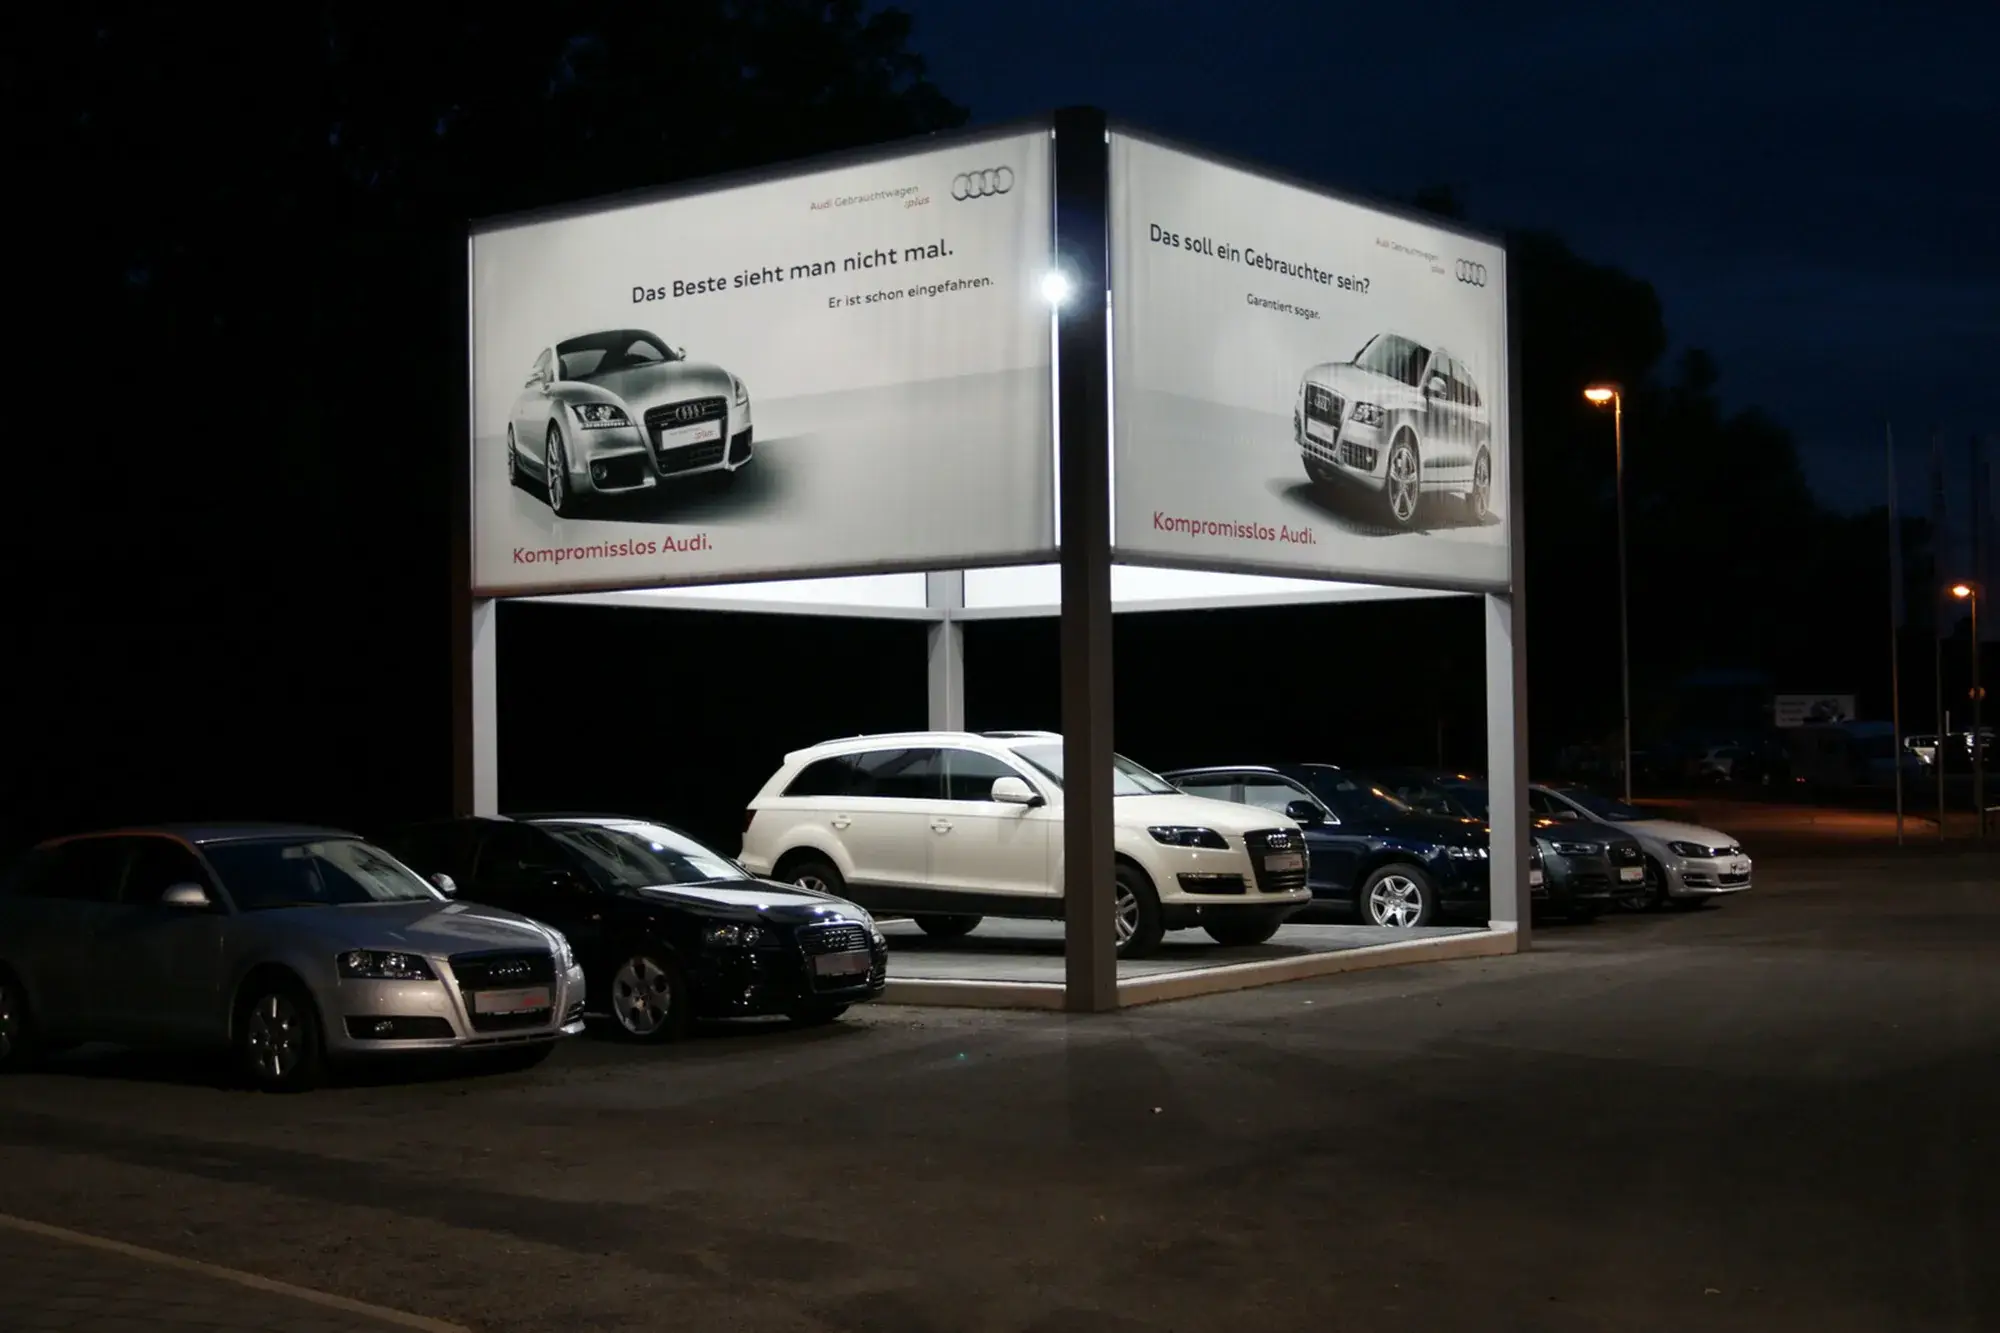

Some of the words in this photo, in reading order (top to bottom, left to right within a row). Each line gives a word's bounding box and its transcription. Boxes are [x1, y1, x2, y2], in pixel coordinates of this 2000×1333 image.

[810, 199, 833, 211] Audi
[835, 185, 919, 208] Gebrauchtwagen
[632, 286, 666, 304] Das
[673, 276, 727, 298] Beste
[734, 266, 784, 289] sieht
[790, 260, 836, 280] man
[844, 248, 897, 272] nicht
[904, 238, 954, 262] mal.
[1150, 223, 1180, 248] Das
[1184, 236, 1213, 256] soll
[1218, 243, 1240, 262] ein
[1245, 248, 1333, 285] Gebrauchter
[1337, 275, 1370, 294] sein?
[828, 297, 841, 309] Er
[846, 295, 861, 307] ist
[865, 289, 904, 304] schon
[908, 276, 994, 298] eingefahren.
[1247, 293, 1292, 314] Garantiert
[1294, 306, 1320, 320] sogar.
[1153, 511, 1275, 541] Kompromisslos
[1280, 525, 1316, 545] Audi.
[513, 538, 656, 565] Kompromisslos
[662, 533, 713, 553] Audi.
